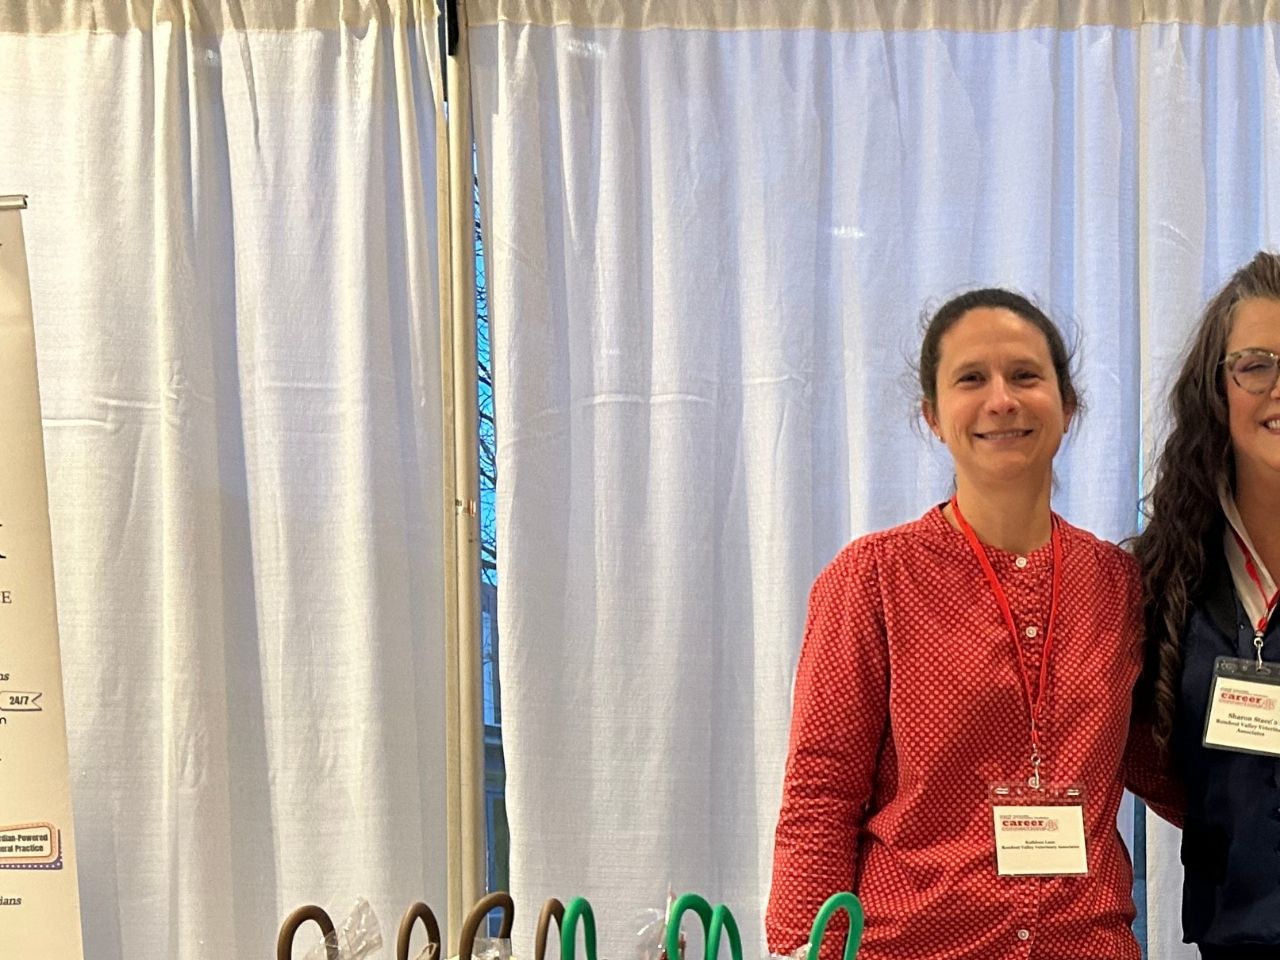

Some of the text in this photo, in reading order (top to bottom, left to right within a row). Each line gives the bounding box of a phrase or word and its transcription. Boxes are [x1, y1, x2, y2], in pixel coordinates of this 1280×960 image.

[9, 695, 30, 705] 24/7
[1221, 692, 1262, 703] career
[1002, 819, 1044, 827] career
